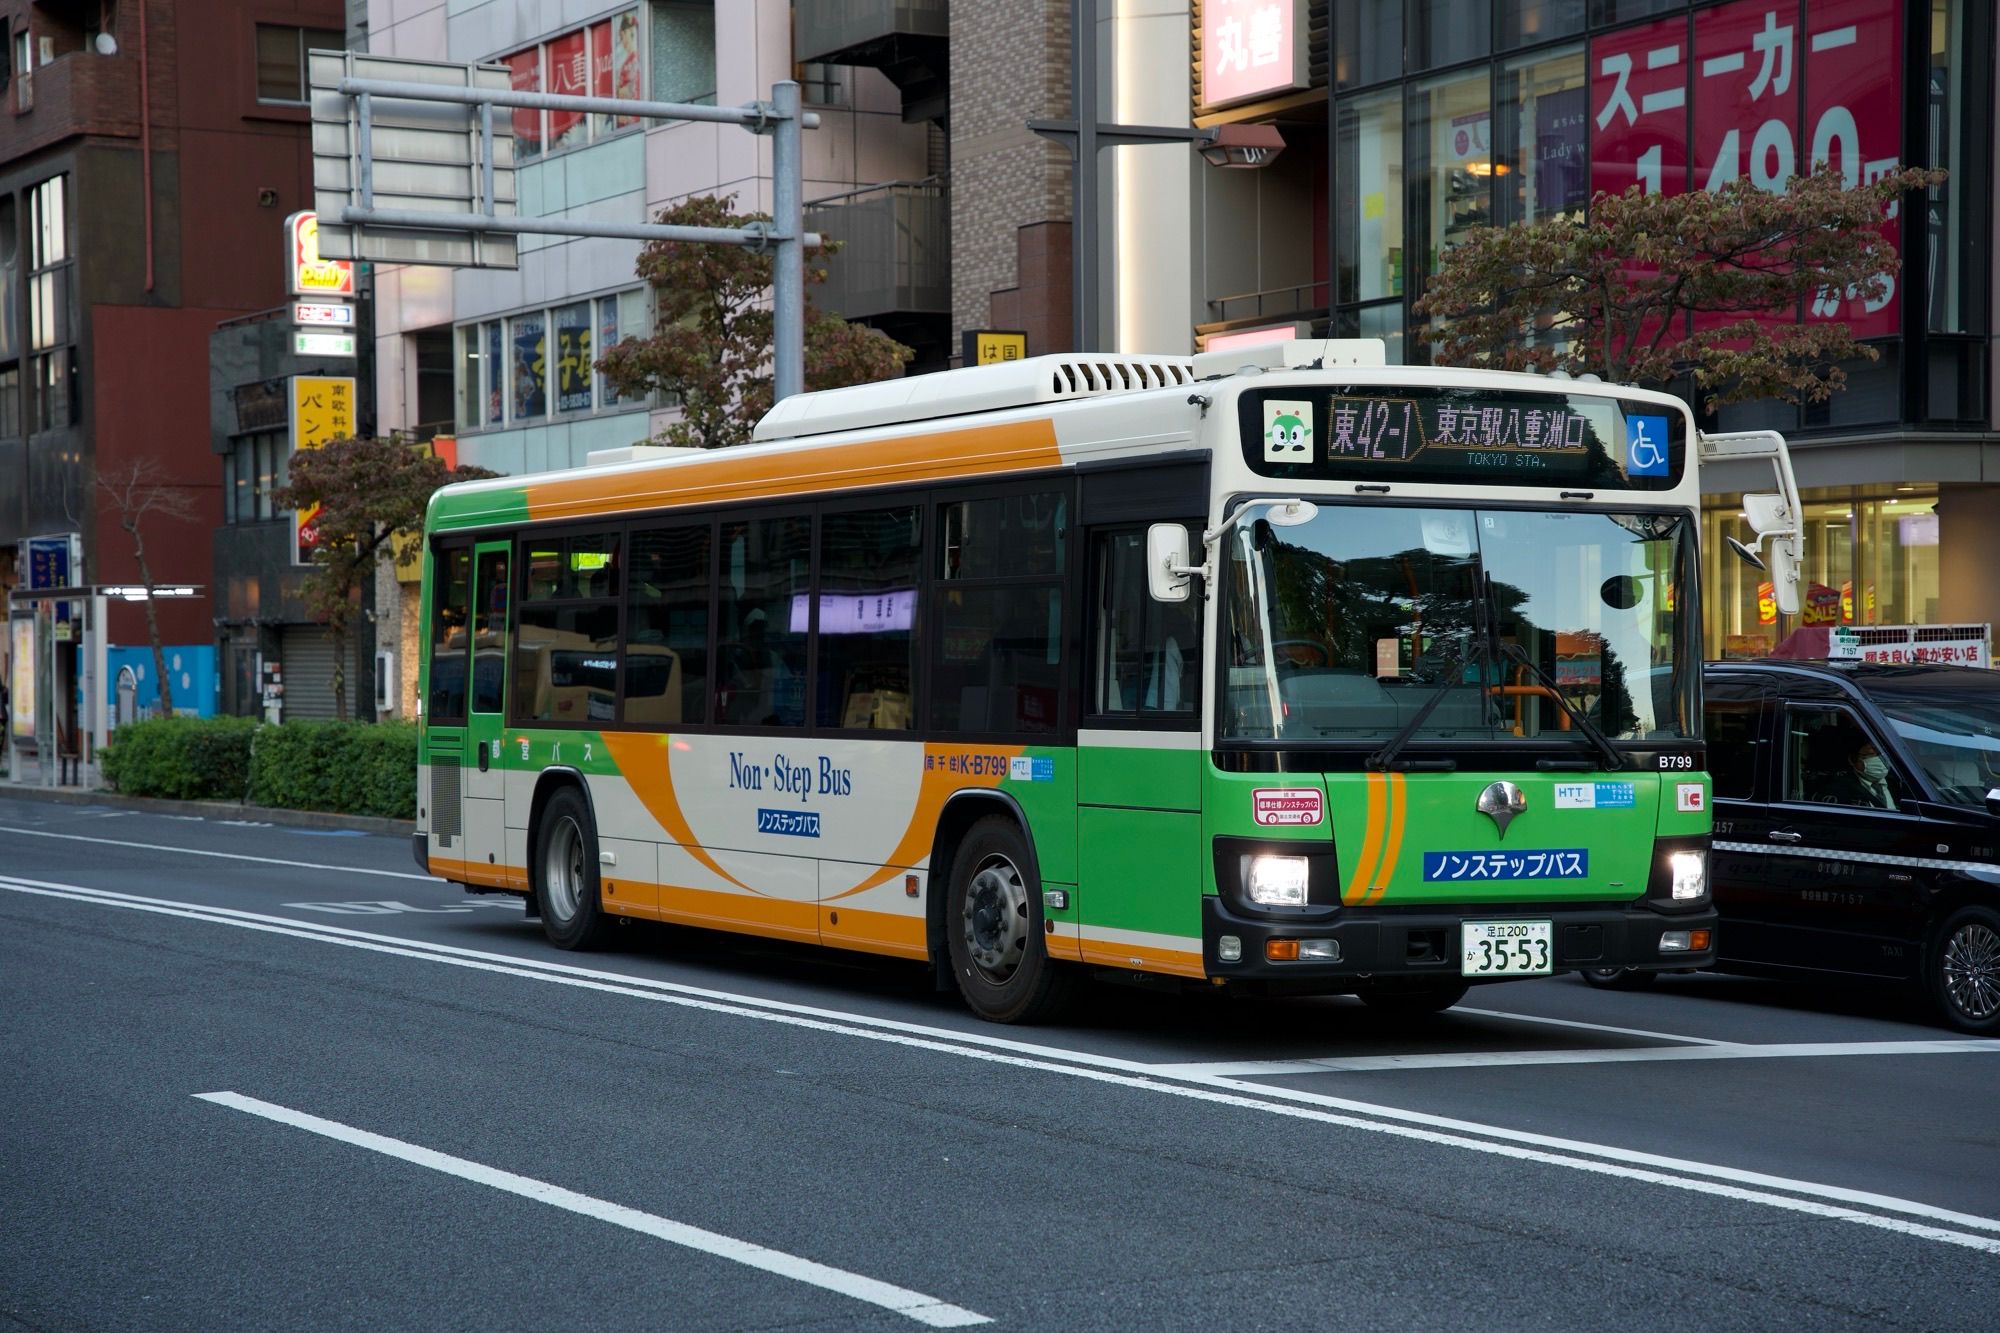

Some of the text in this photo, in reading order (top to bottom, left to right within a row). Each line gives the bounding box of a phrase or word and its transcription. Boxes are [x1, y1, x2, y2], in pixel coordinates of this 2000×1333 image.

[1215, 4, 1282, 76] 丸善
[1596, 11, 1857, 131] スニーカー
[1543, 142, 1572, 160] Lady
[1434, 404, 1585, 449] 東京駅八重洲口
[1467, 452, 1547, 468] TOKYO STA.
[1803, 600, 1837, 624] SALE
[1841, 647, 1857, 656] 7157
[960, 754, 1007, 776] K-B799
[1658, 756, 1692, 769] B799
[818, 756, 852, 796] Bus
[1558, 787, 1583, 798] HTT
[758, 812, 820, 836] ノンステップバス
[1432, 852, 1583, 879] ノンステップバス
[1466, 951, 1476, 961] か
[1478, 939, 1548, 971] 35-53
